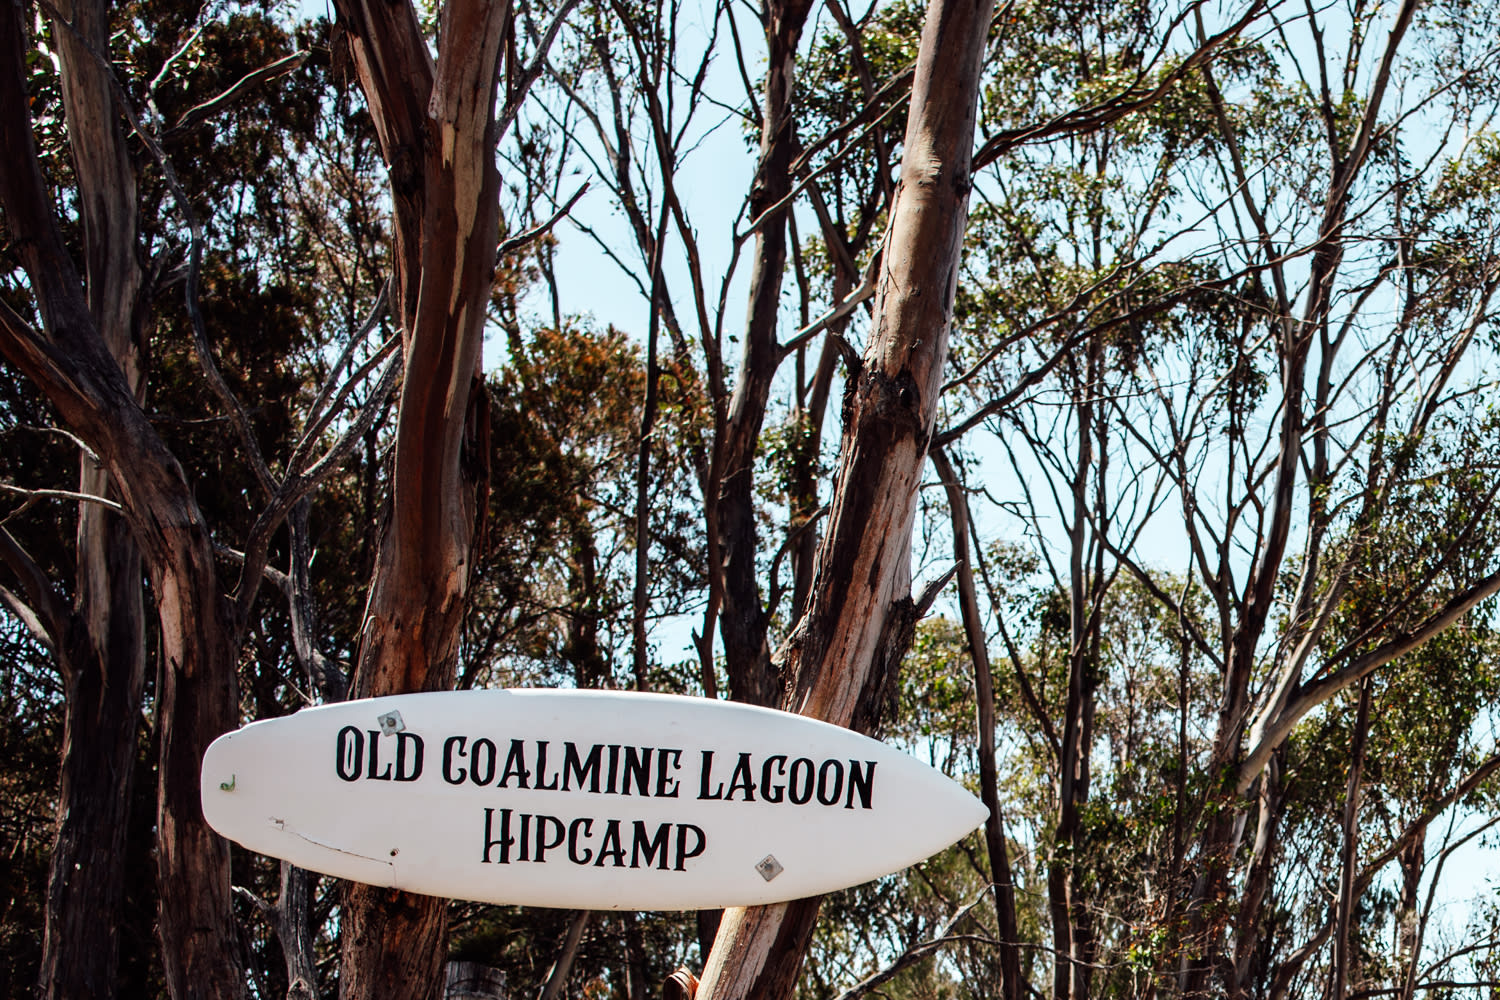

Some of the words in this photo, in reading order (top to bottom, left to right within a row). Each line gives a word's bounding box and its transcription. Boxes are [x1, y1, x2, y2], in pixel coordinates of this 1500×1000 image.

[335, 725, 425, 783] OLD
[442, 735, 683, 799] COALMINE
[697, 750, 878, 811] LAGOON
[481, 807, 707, 872] HIPCAMP
